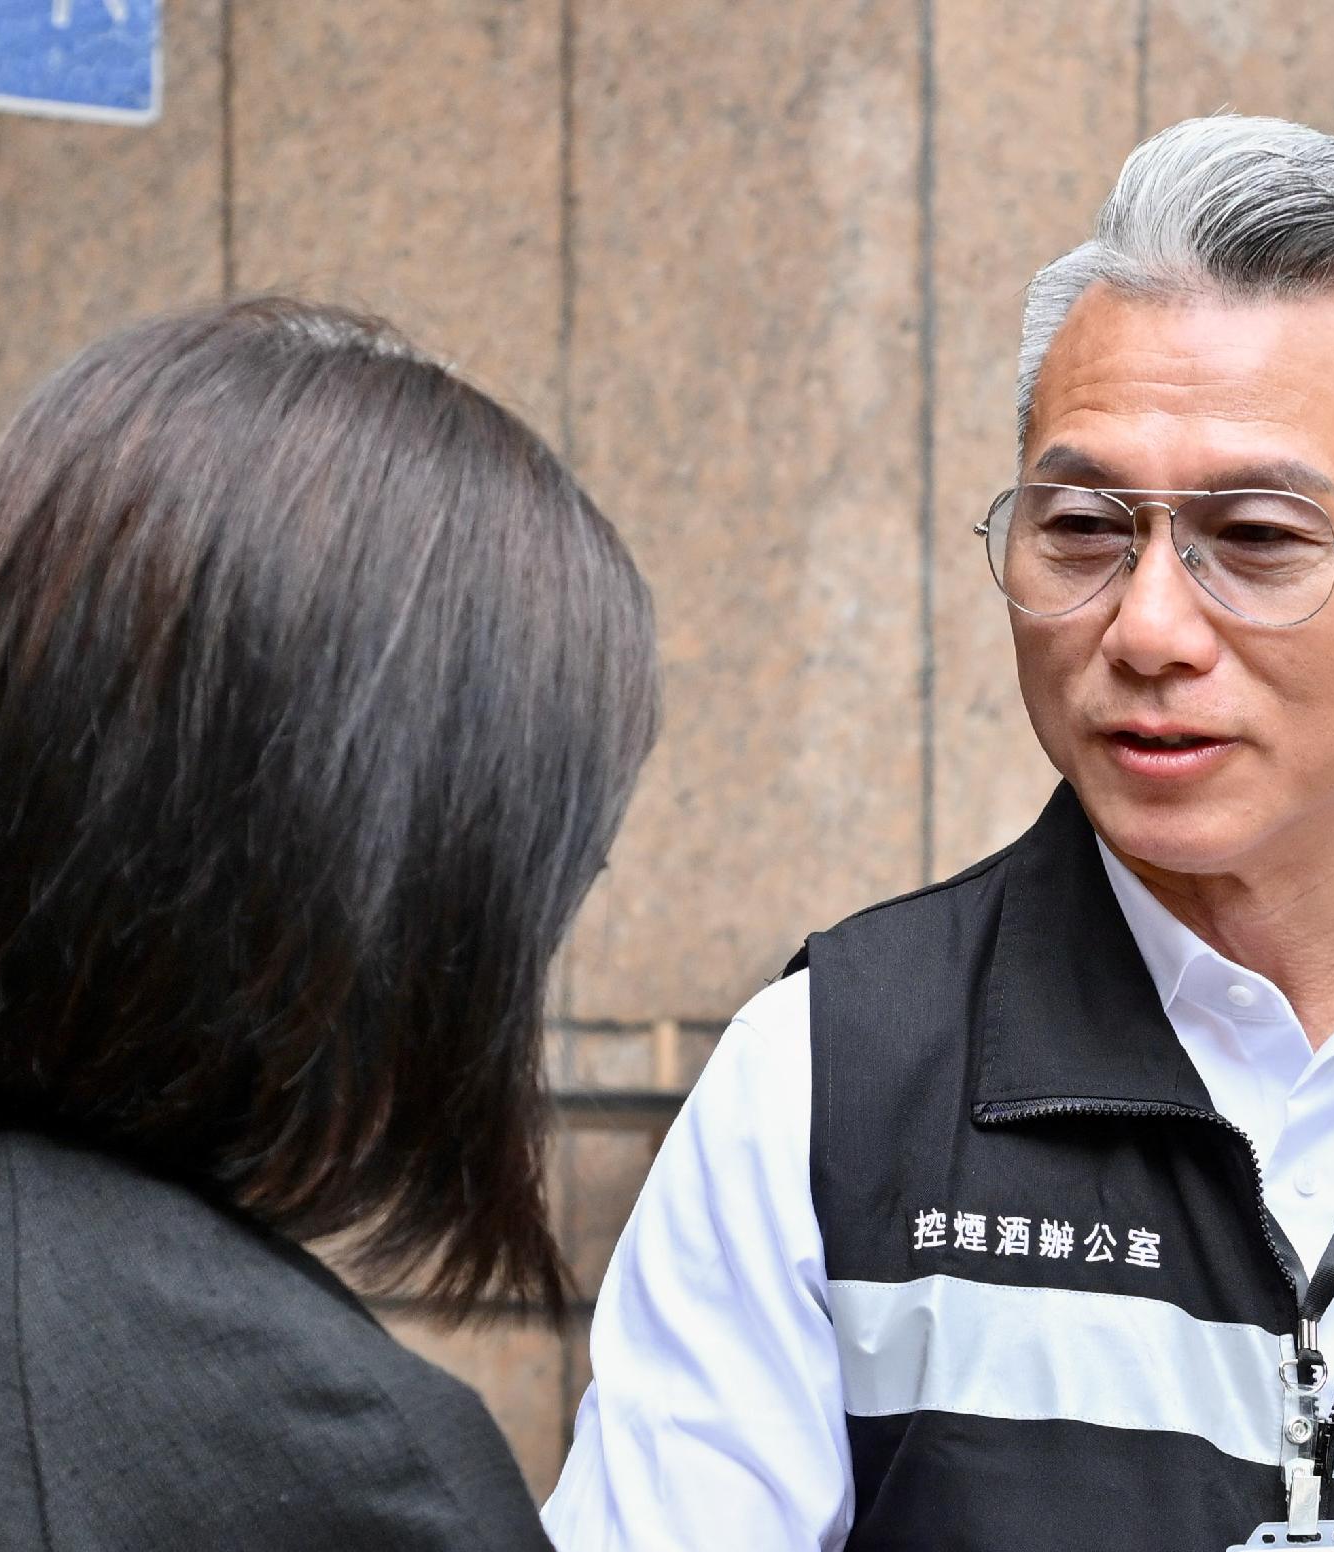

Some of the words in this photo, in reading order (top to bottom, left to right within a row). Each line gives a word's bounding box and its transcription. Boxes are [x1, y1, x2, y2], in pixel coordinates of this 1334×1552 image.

[913, 1207, 1162, 1269] 控煙酒辦公室
